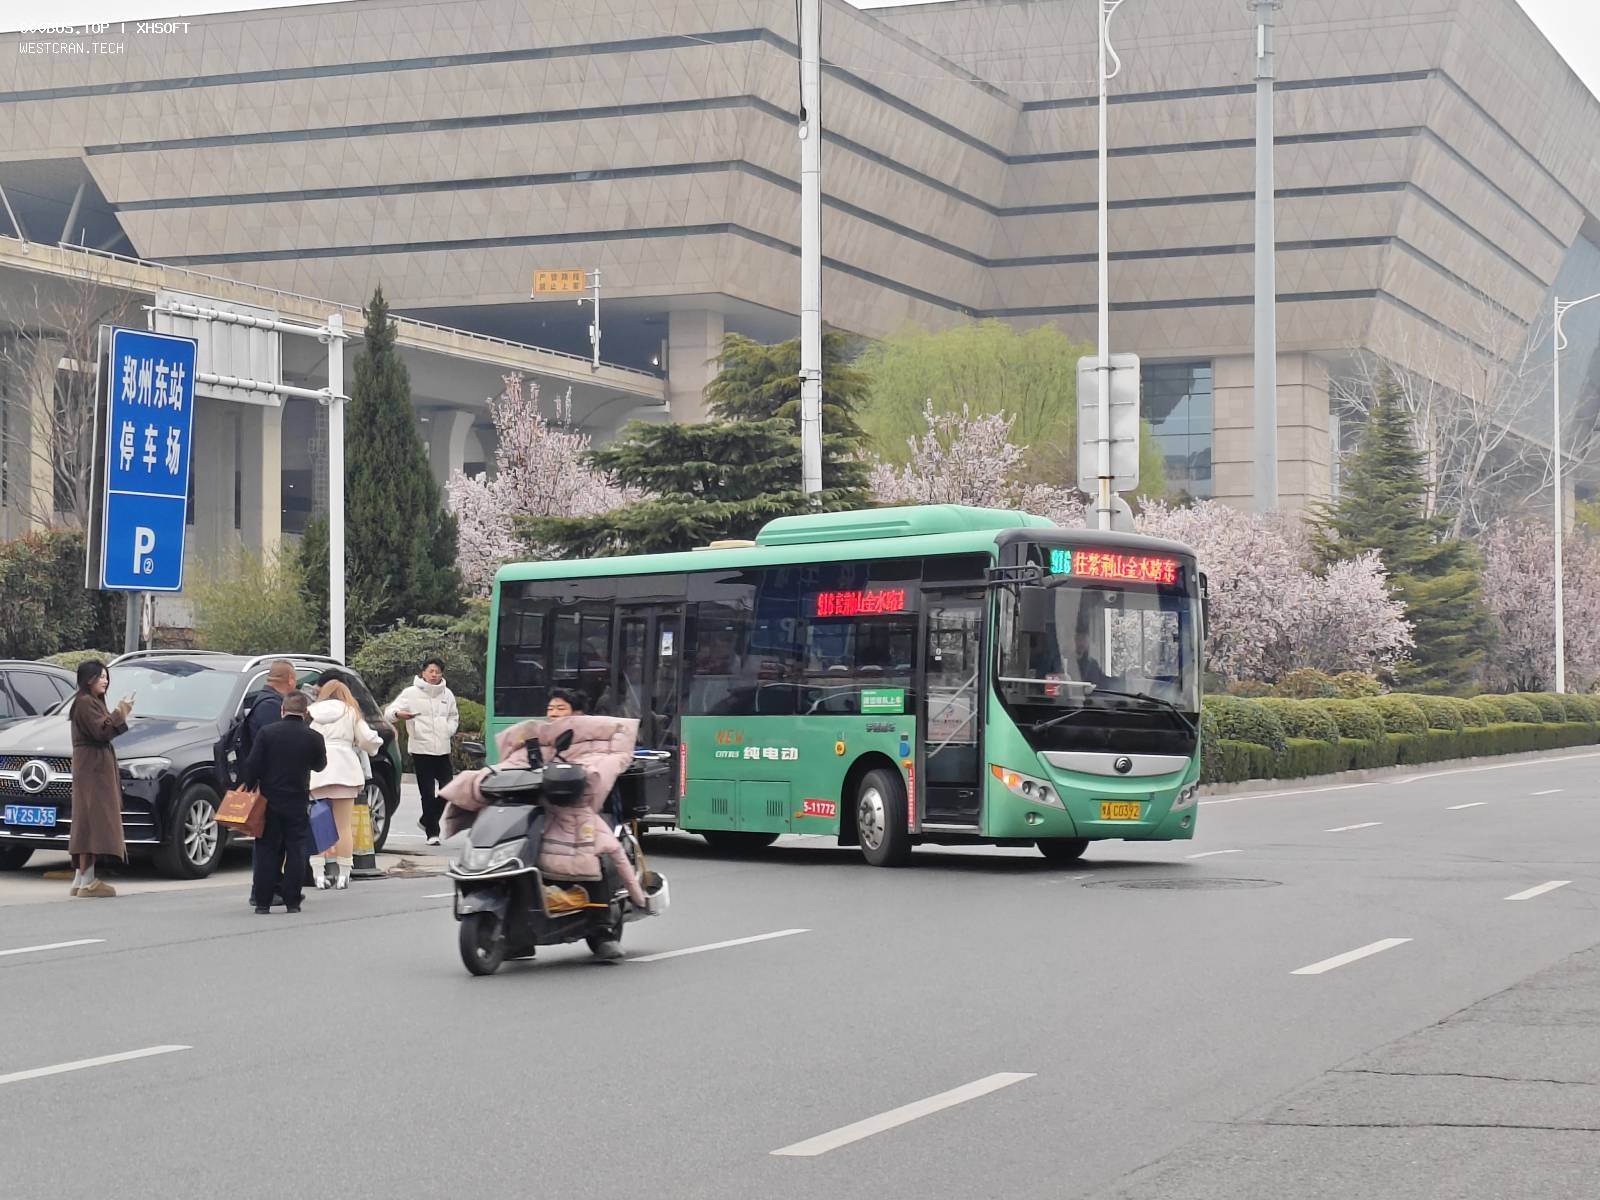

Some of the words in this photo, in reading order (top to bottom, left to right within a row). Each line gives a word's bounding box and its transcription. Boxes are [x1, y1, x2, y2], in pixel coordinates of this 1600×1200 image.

[121, 355, 185, 411] 郑州东站
[119, 421, 181, 475] 停车场
[743, 746, 799, 760] 纯电动
[803, 801, 836, 815] 5-11772
